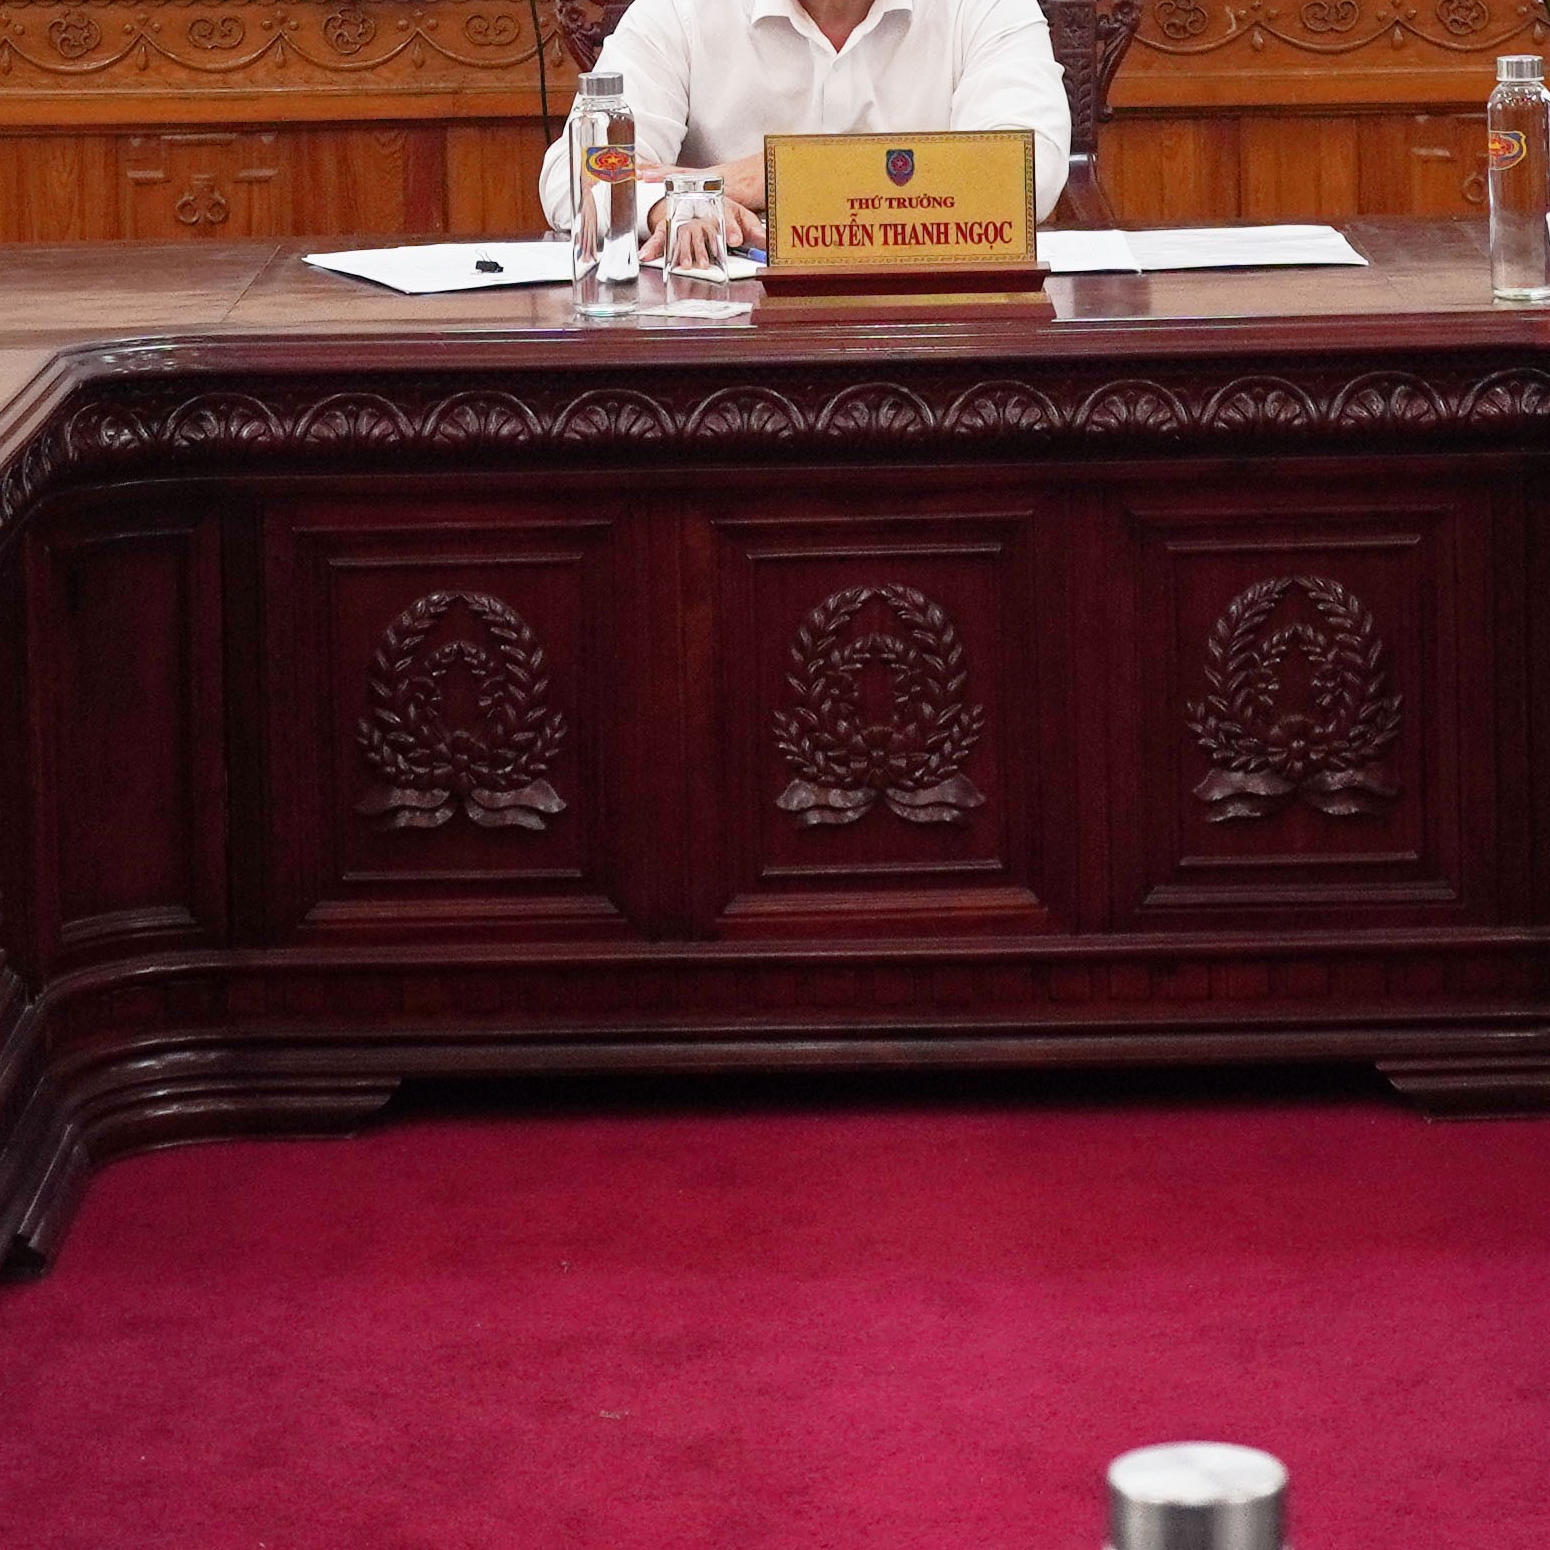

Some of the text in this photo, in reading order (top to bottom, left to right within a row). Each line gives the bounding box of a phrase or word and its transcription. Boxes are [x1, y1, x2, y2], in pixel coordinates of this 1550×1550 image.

[847, 193, 956, 210] THỨ TRƯỞNG
[791, 213, 1013, 250] NGUYỄN THANH NGỌC
